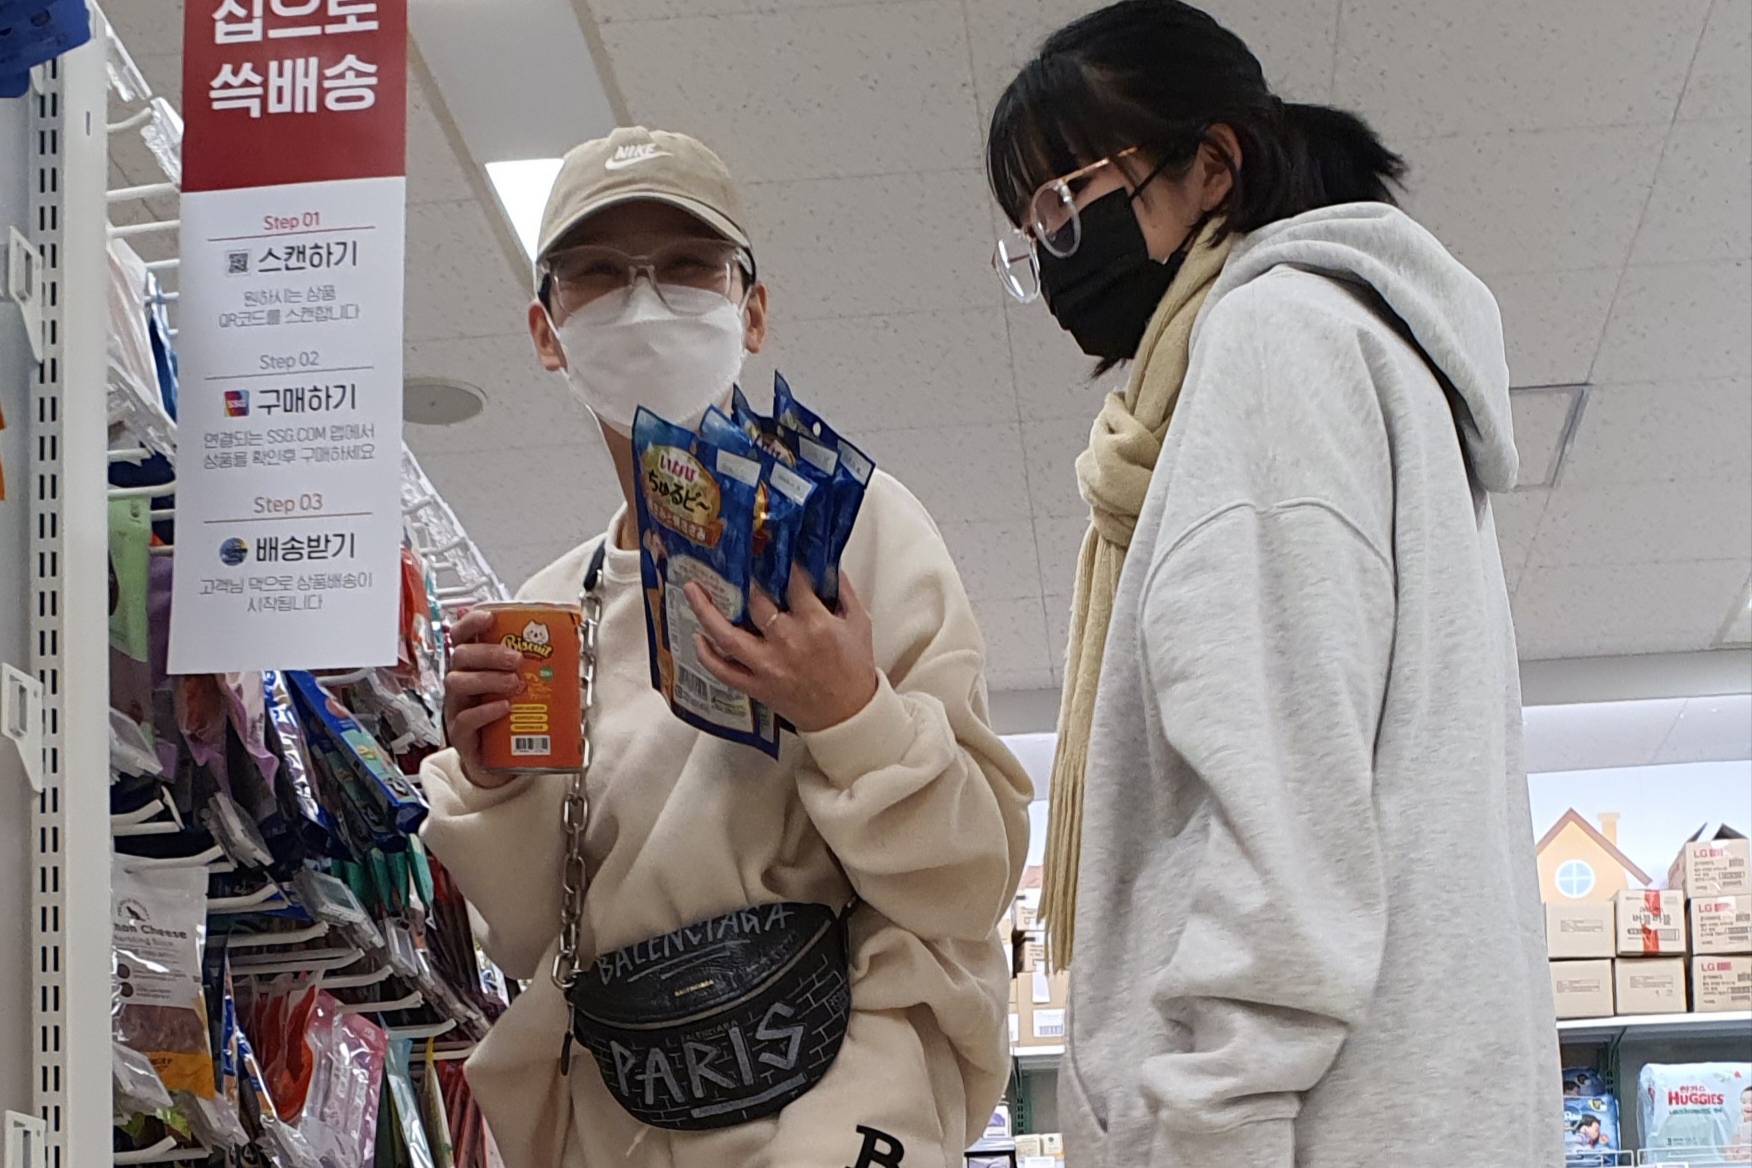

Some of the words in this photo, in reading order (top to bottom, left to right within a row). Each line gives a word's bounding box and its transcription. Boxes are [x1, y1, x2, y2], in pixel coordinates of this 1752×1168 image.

[209, 54, 379, 118] 쓱배송
[615, 143, 657, 160] NIKE
[263, 215, 300, 231] Step
[302, 211, 321, 227] 01
[257, 241, 358, 273] 스캔하기
[243, 288, 303, 307] 원하시는
[306, 285, 337, 303] 상품
[284, 304, 361, 324] 스캔합니다
[259, 354, 296, 371] Step
[299, 350, 319, 367] 02
[257, 384, 356, 415] 구매하기
[266, 426, 327, 445] SSG.COM
[253, 496, 295, 515] Step
[299, 493, 324, 511] 03
[255, 533, 355, 562] 배송받기
[199, 578, 245, 595] 고객님
[247, 594, 323, 613] 시작됩니다
[501, 634, 554, 659] Biscuit
[1693, 849, 1709, 859] LG
[1698, 904, 1713, 914] LG
[141, 924, 187, 939] Cheese
[1700, 962, 1716, 973] LG
[607, 1001, 806, 1106] PARIS
[1667, 1090, 1725, 1107] HUGGIES
